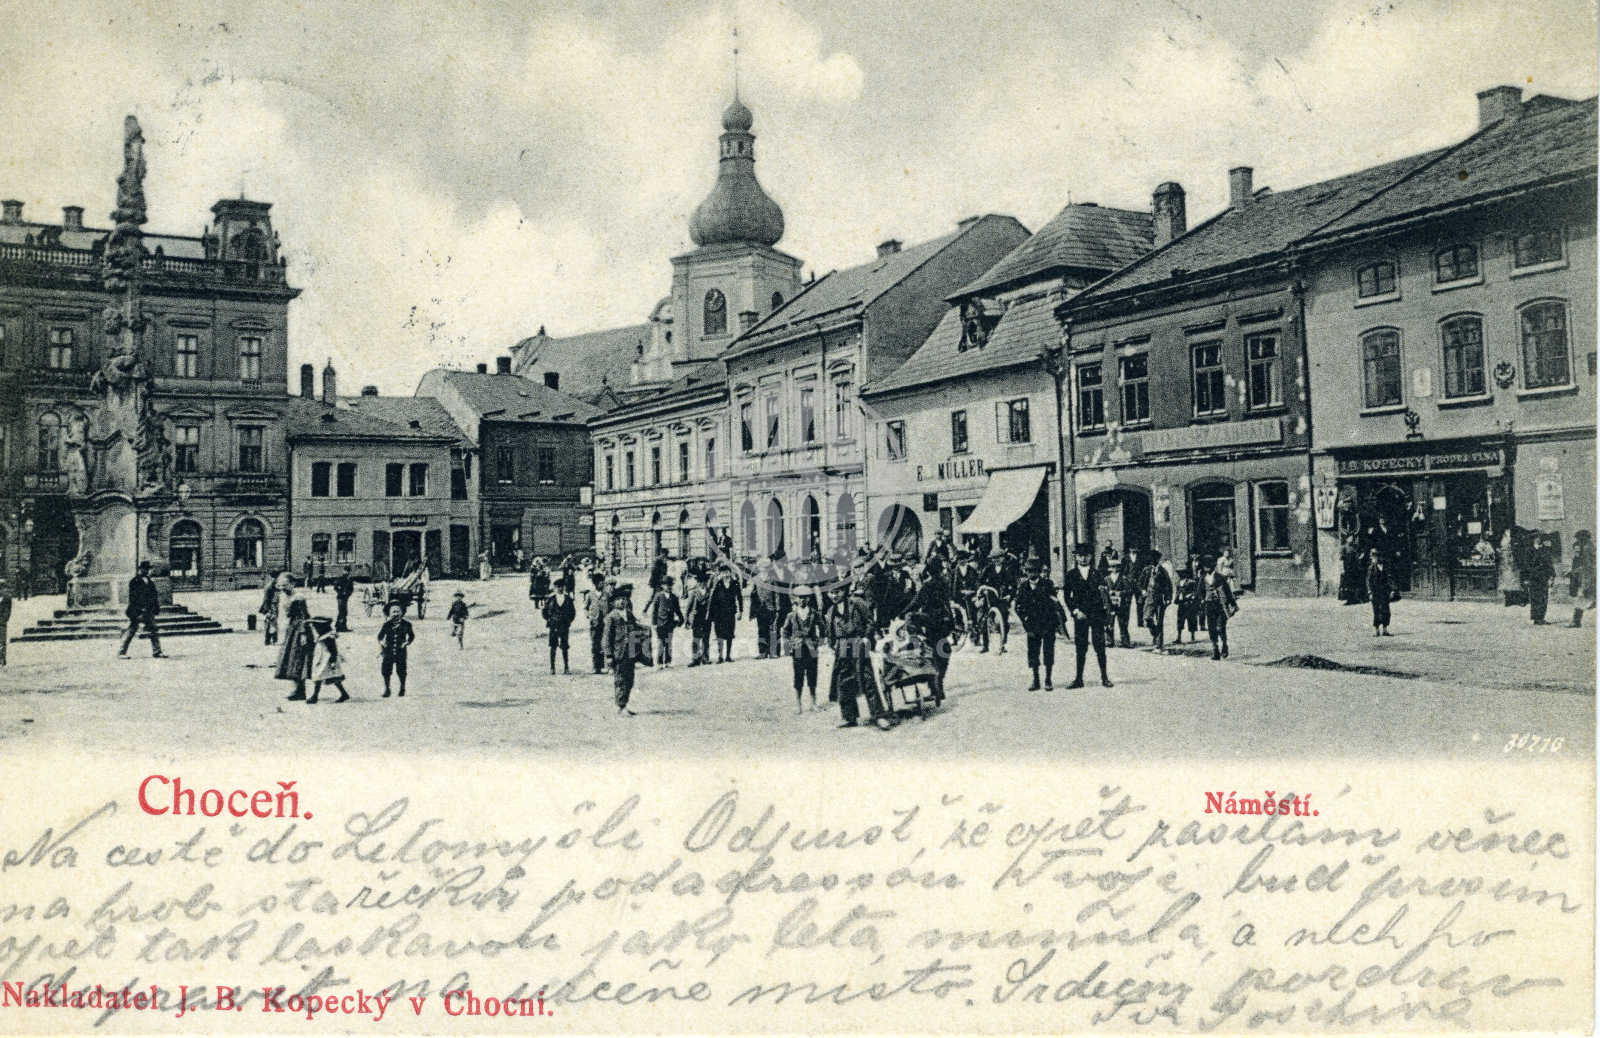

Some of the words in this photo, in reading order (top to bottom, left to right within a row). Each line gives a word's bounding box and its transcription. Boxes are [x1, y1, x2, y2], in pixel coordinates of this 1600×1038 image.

[138, 774, 314, 819] Choceň.
[1204, 790, 1320, 817] Náměstí.
[2, 800, 118, 873] Na
[246, 823, 324, 864] do
[2, 981, 158, 1010] Nakladatel
[175, 985, 197, 1019] J.
[215, 985, 243, 1013] B.
[261, 987, 391, 1022] Kopecký
[409, 996, 426, 1016] v
